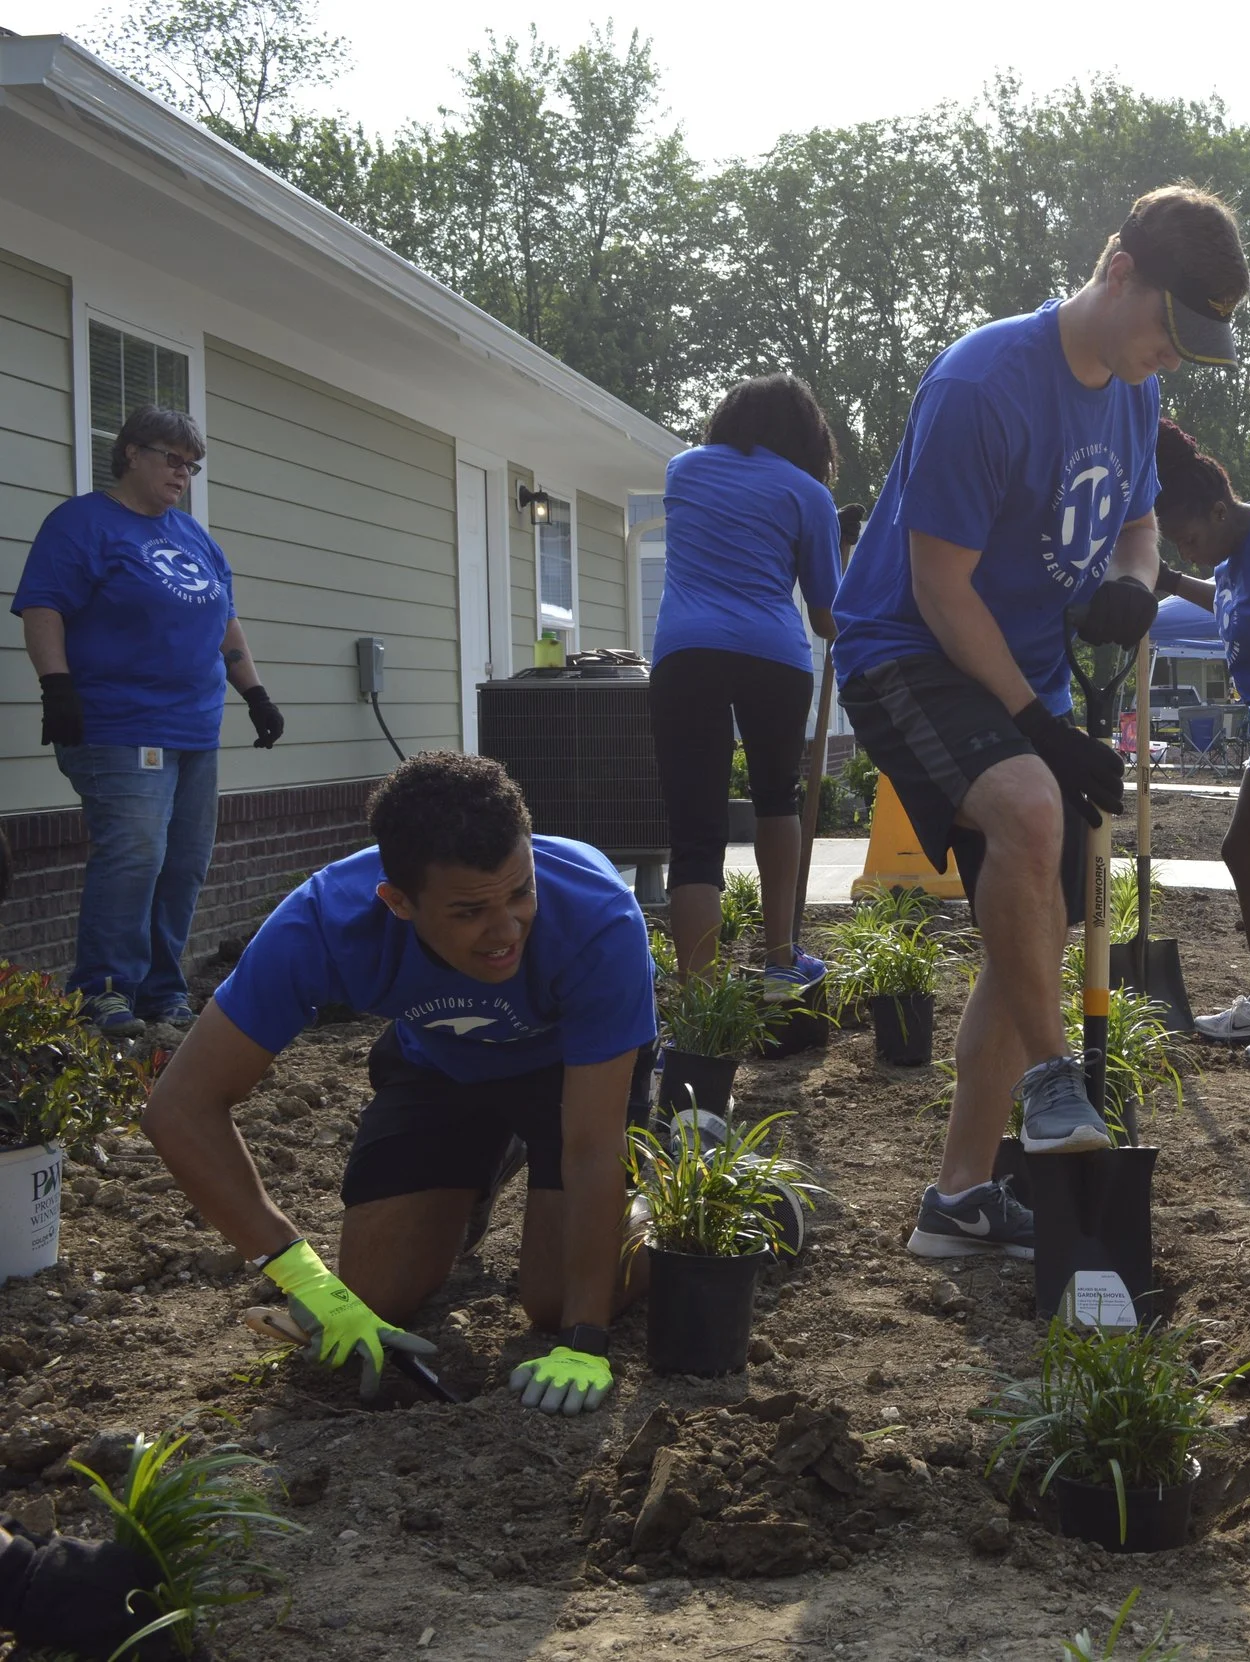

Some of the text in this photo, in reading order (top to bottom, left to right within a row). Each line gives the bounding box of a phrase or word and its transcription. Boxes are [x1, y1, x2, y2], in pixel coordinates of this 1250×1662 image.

[1109, 449, 1124, 478] NITED
[1041, 533, 1052, 542] A
[1042, 552, 1075, 589] DECAD
[162, 579, 193, 603] DECADE
[1093, 856, 1105, 928] YARDWORKS
[405, 997, 473, 1021] SOLUTIONS
